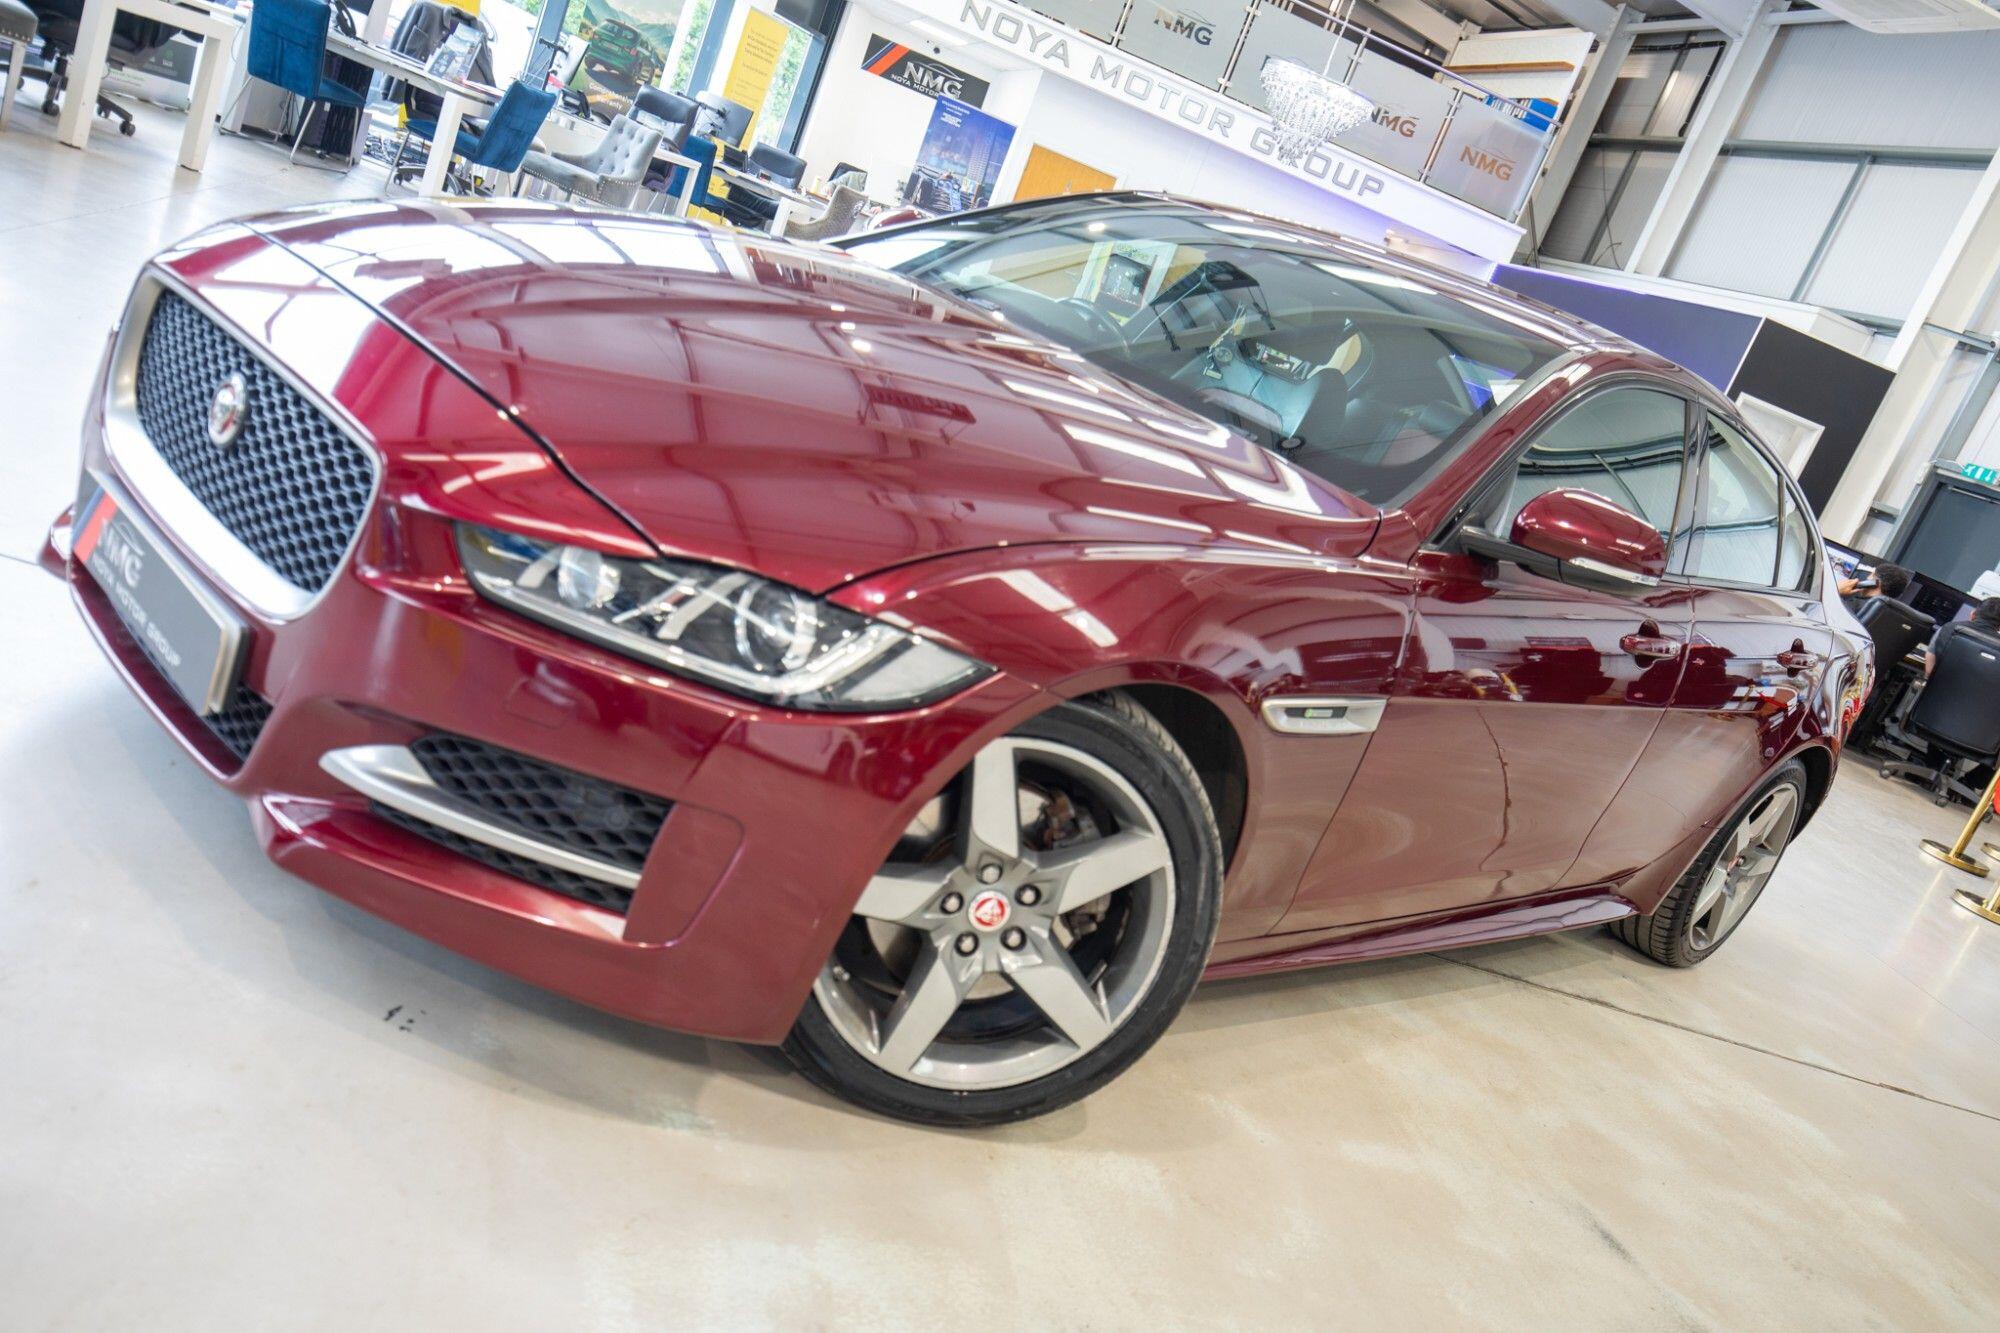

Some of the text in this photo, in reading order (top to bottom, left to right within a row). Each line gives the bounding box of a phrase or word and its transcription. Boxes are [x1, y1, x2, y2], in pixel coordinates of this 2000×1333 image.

[1153, 8, 1213, 46] NMG
[891, 74, 911, 88] NOYA
[902, 61, 963, 99] NMG
[960, 0, 1070, 68] NOYA
[1090, 55, 1235, 138] MOTOR
[1459, 144, 1514, 182] NMG
[115, 583, 147, 627] MOTOR
[146, 622, 181, 667] GROUP
